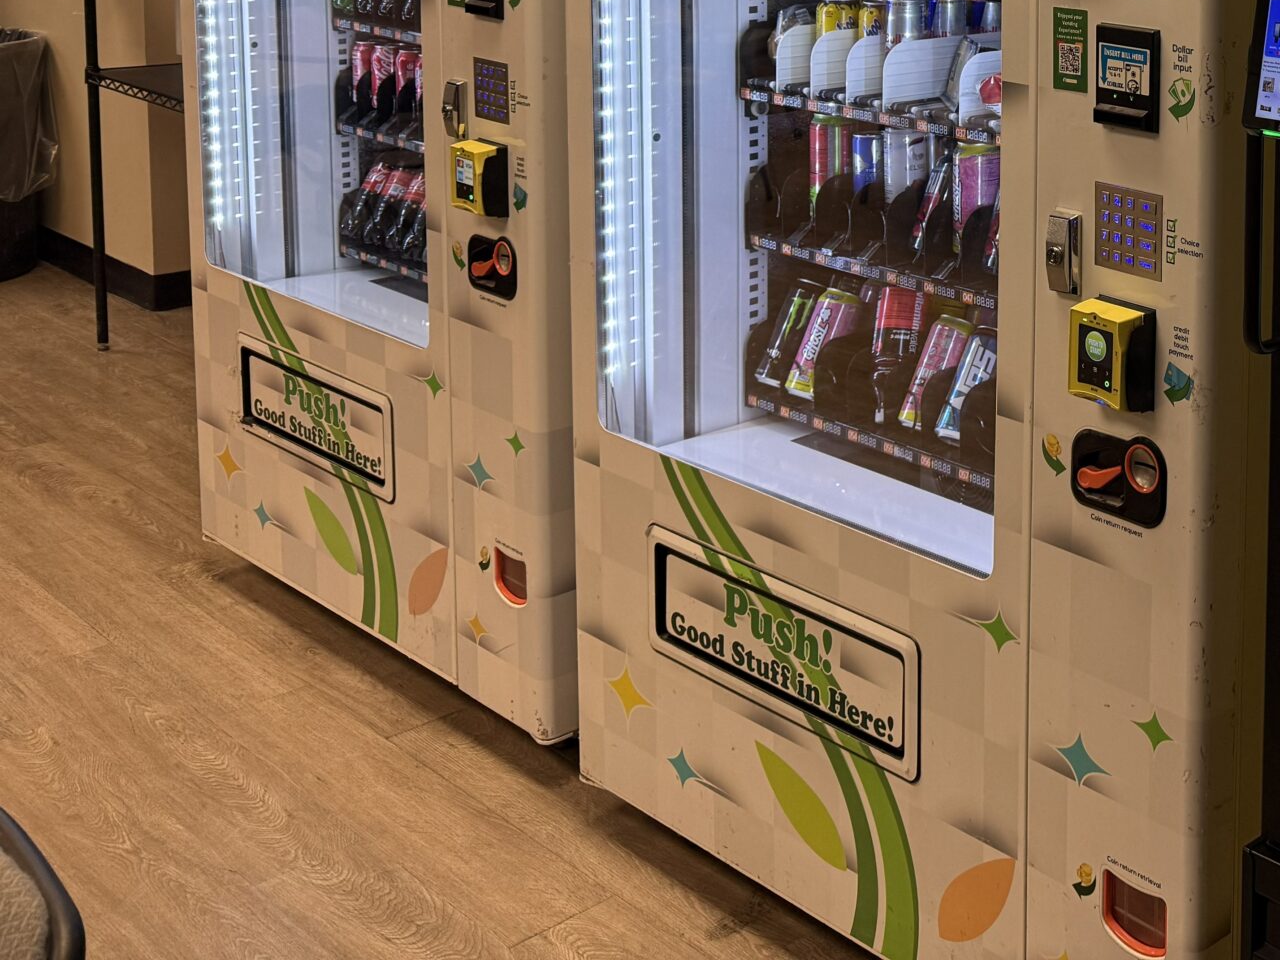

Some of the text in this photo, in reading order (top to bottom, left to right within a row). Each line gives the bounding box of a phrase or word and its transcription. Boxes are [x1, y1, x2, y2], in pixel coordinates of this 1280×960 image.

[1172, 44, 1194, 56] Dollar
[1178, 53, 1188, 63] bill
[1173, 62, 1192, 74] input
[1180, 237, 1200, 248] Choice
[1177, 247, 1203, 259] selection
[1173, 325, 1190, 336] credit
[1173, 333, 1189, 344] debit
[1173, 341, 1189, 352] touch
[1168, 348, 1194, 361] payment
[283, 373, 346, 432] Push!
[254, 398, 382, 476] Good Stuff in Here!
[1090, 513, 1143, 538] Coin return request
[722, 582, 833, 674] Push!
[670, 611, 895, 743] Good Stuff in Here!
[1106, 855, 1162, 889] Coin return retrieval
